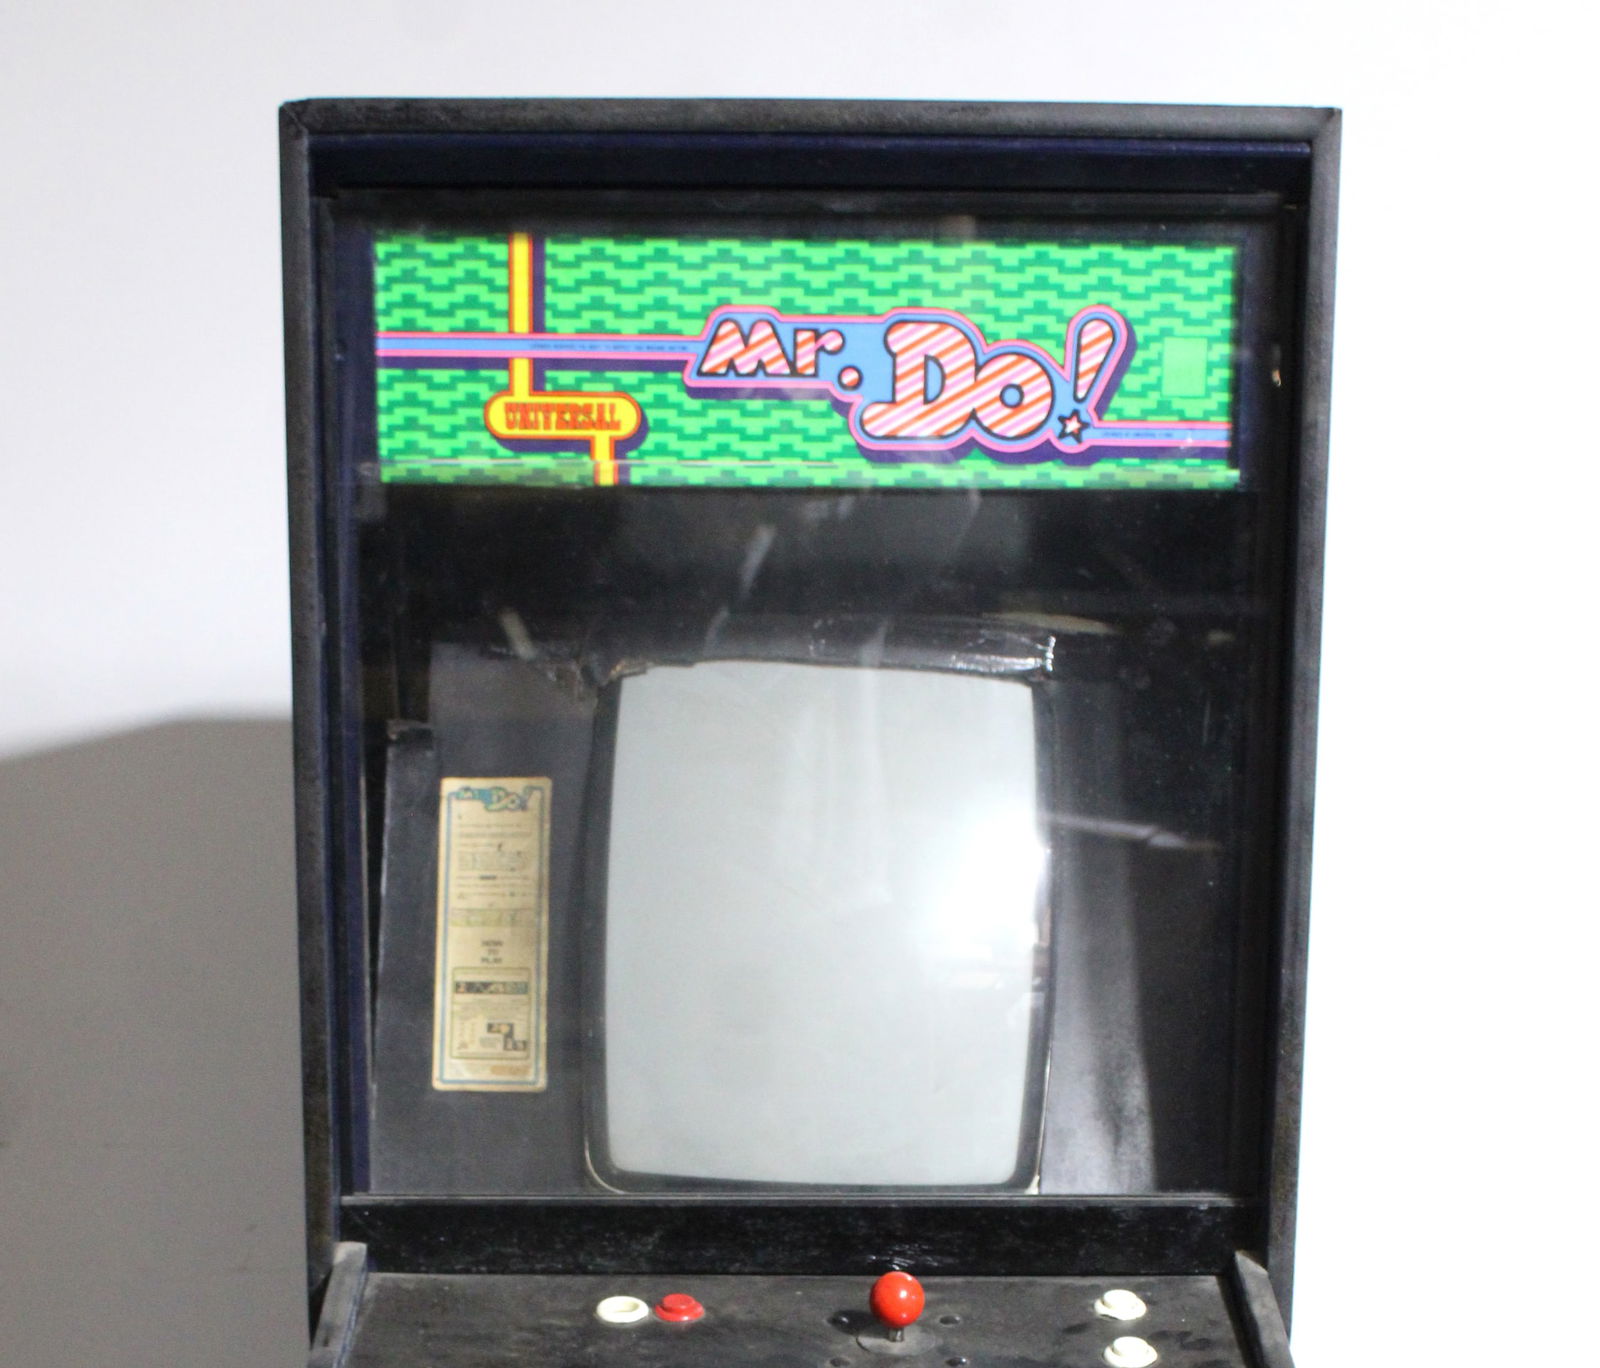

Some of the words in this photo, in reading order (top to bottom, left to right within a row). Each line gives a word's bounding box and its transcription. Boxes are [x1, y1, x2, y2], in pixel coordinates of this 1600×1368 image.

[504, 402, 621, 431] UNIVERSAL
[697, 318, 863, 392] Mr.
[860, 318, 1115, 443] Do!
